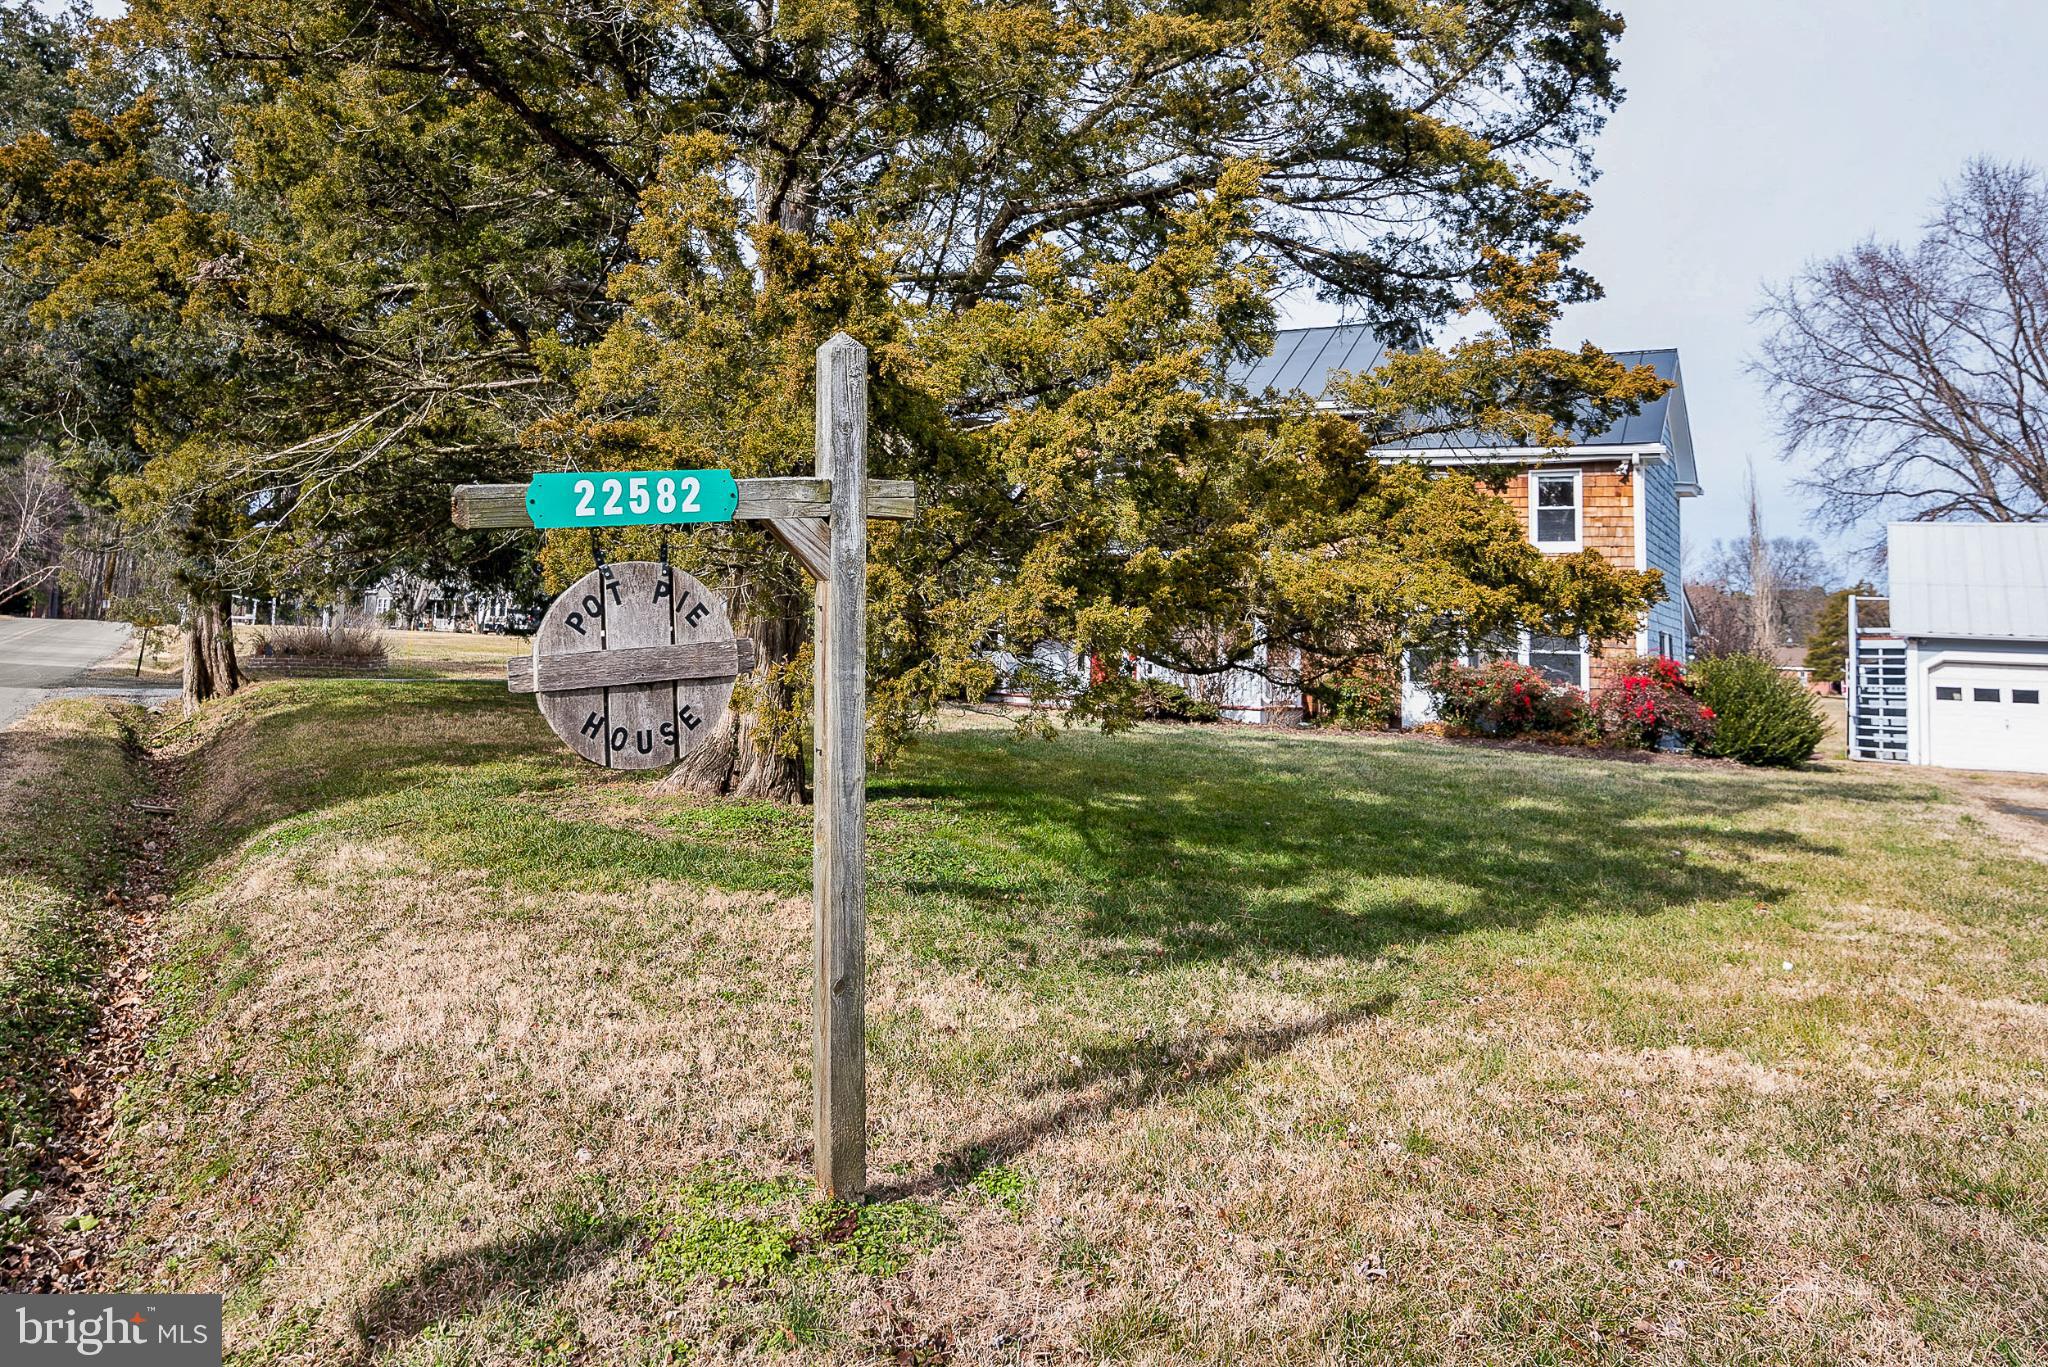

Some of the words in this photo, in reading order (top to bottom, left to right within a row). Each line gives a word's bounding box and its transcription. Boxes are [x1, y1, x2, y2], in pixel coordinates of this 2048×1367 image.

[574, 477, 701, 517] 22582
[565, 580, 623, 636] POT
[652, 579, 710, 629] PIE
[579, 704, 702, 756] HOUSE
